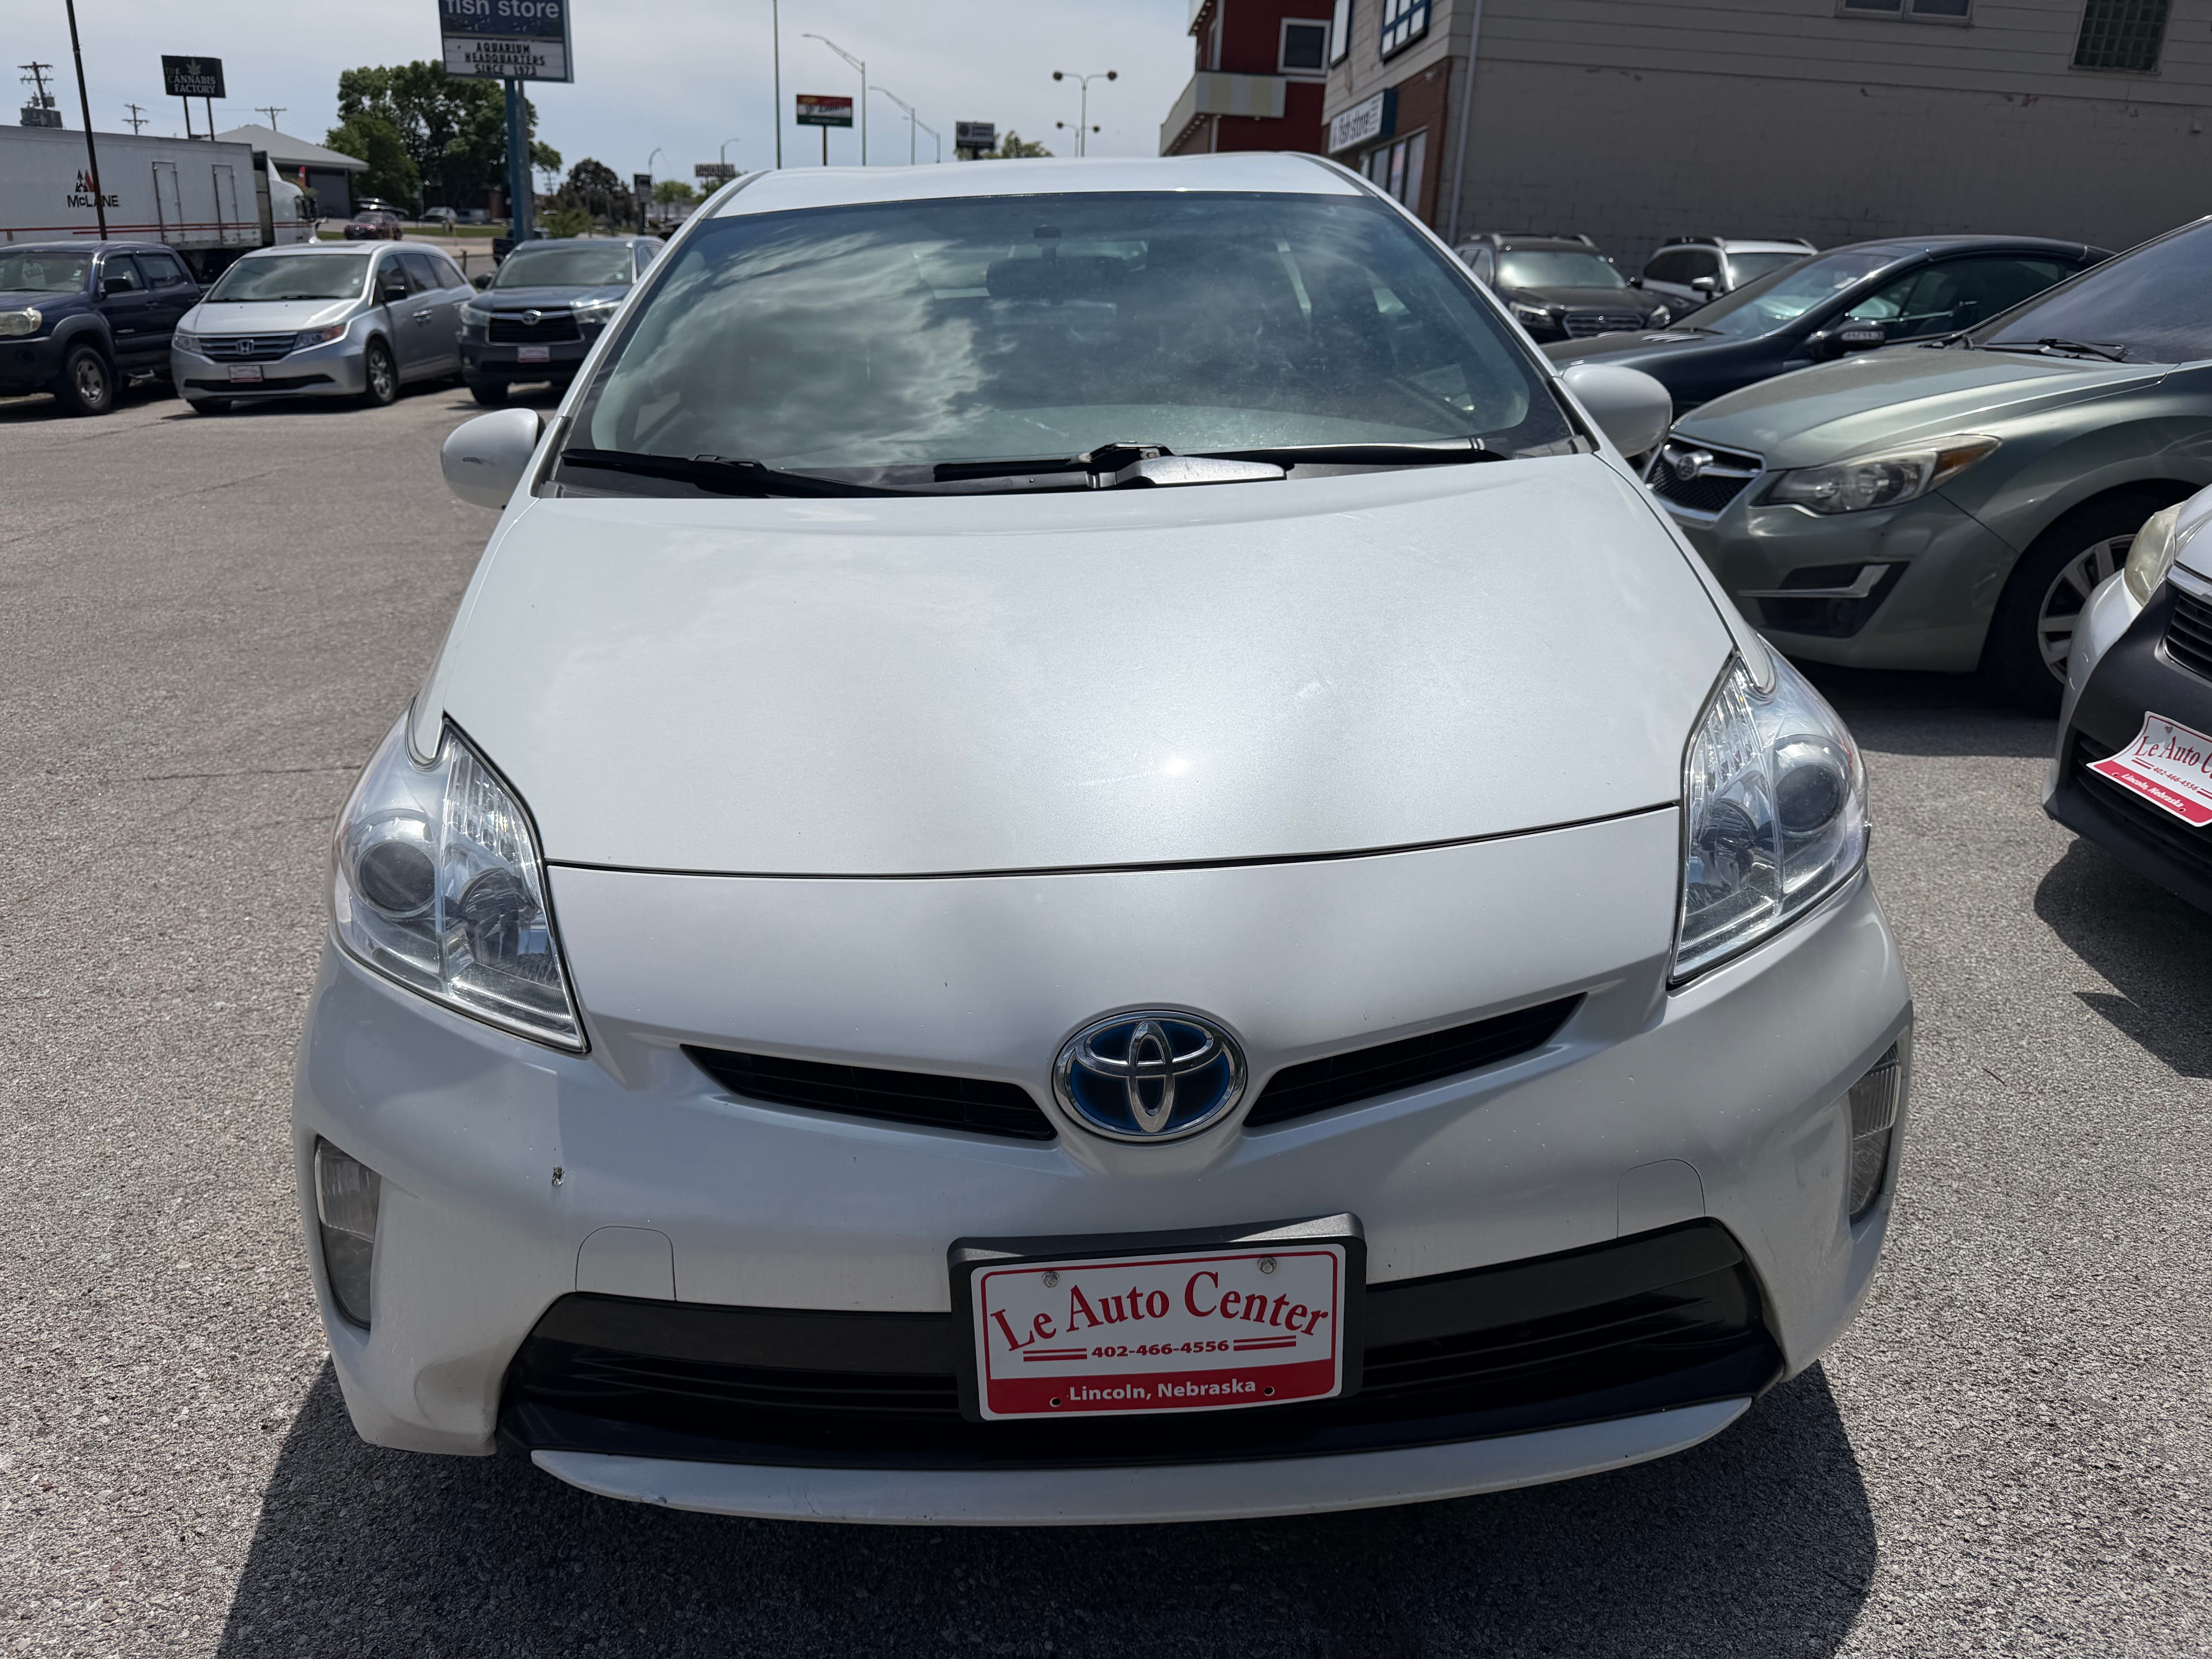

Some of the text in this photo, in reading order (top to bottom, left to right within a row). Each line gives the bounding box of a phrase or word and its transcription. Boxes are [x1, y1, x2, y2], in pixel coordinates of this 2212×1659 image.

[447, 0, 560, 18] fish store
[476, 42, 530, 53] AQUARIUM
[465, 52, 545, 66] HEADQUARTERS
[474, 63, 537, 76] SINCE 1973
[167, 75, 216, 85] CANNABIS
[174, 84, 216, 94] FACTORY
[2133, 736, 2159, 756] Le
[2158, 736, 2200, 766] Auto
[2153, 767, 2199, 791] 402-466-4556
[2121, 773, 2184, 808] Lincoln, Nebraska
[990, 1271, 1328, 1351] Le Auto Center
[1091, 1339, 1230, 1358] 402-466-4556
[1070, 1378, 1256, 1401] Lincoln, Nebraska
